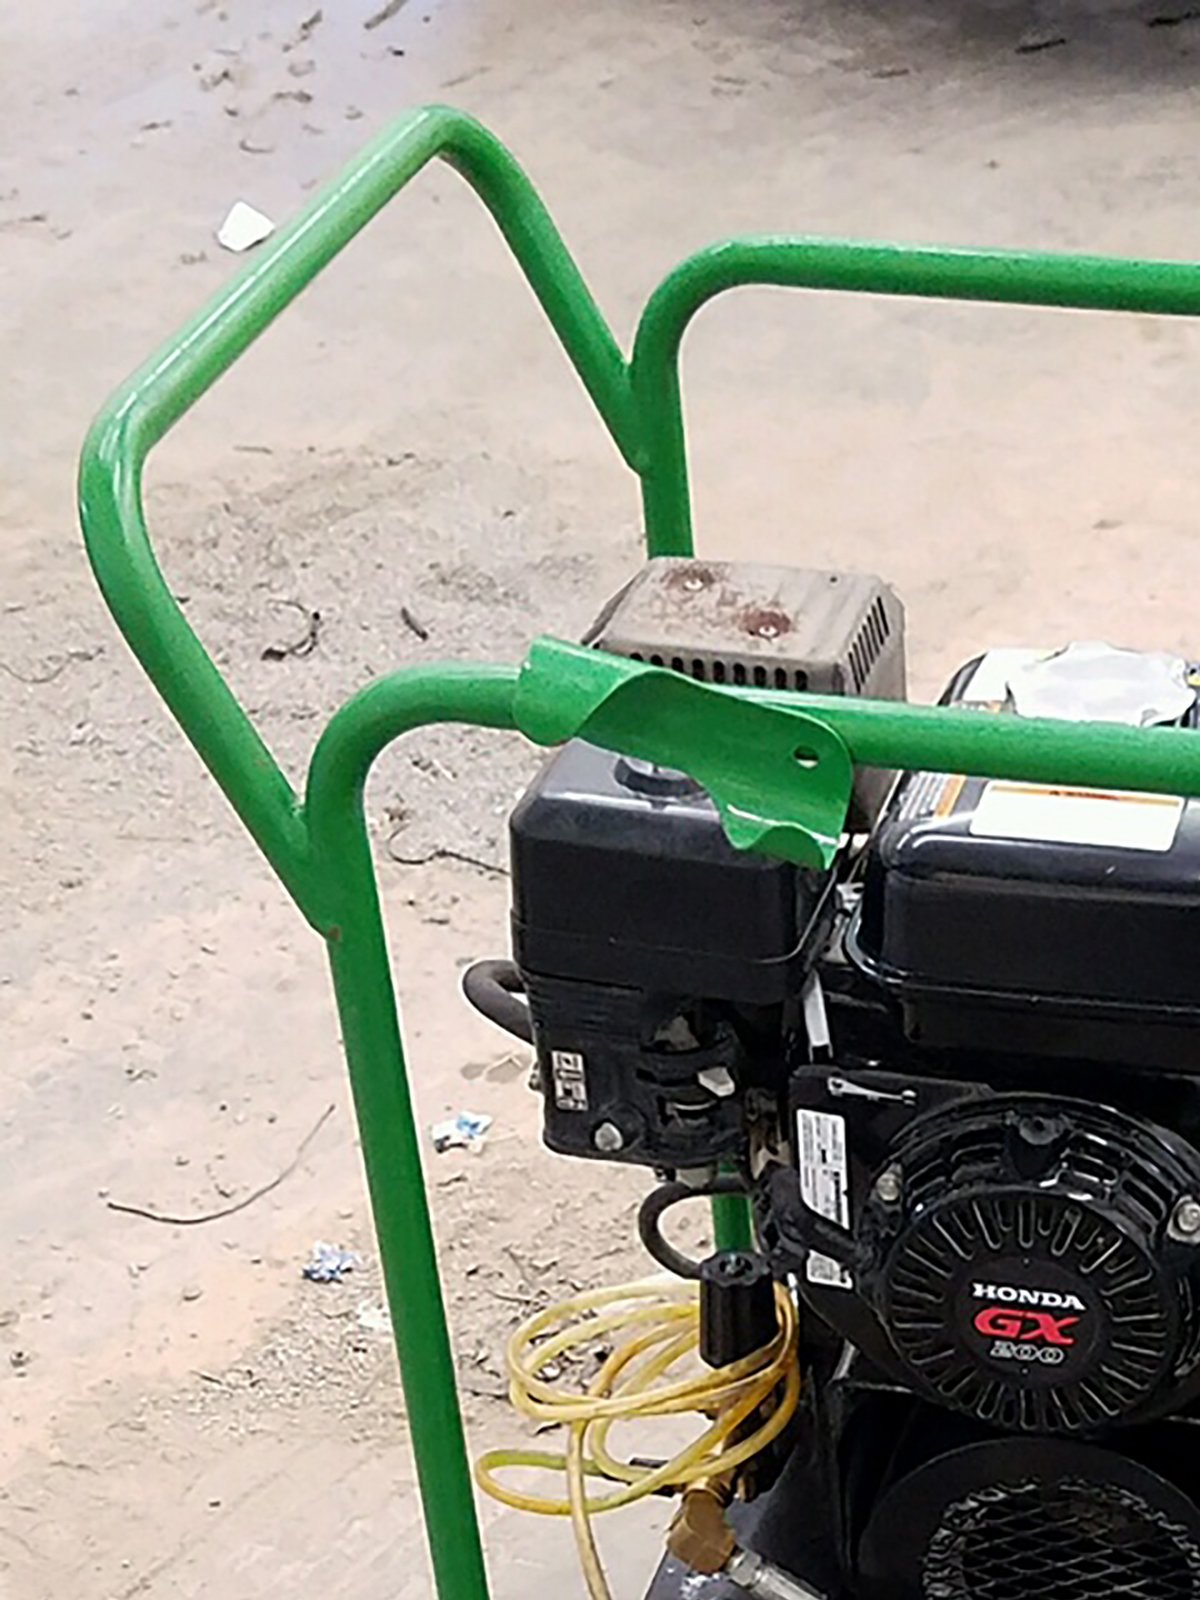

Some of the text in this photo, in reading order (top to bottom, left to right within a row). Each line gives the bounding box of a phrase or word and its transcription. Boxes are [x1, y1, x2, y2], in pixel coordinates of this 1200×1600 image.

[972, 1282, 1086, 1310] HONDA
[974, 1305, 1081, 1346] GX
[989, 1340, 1064, 1364] 200
